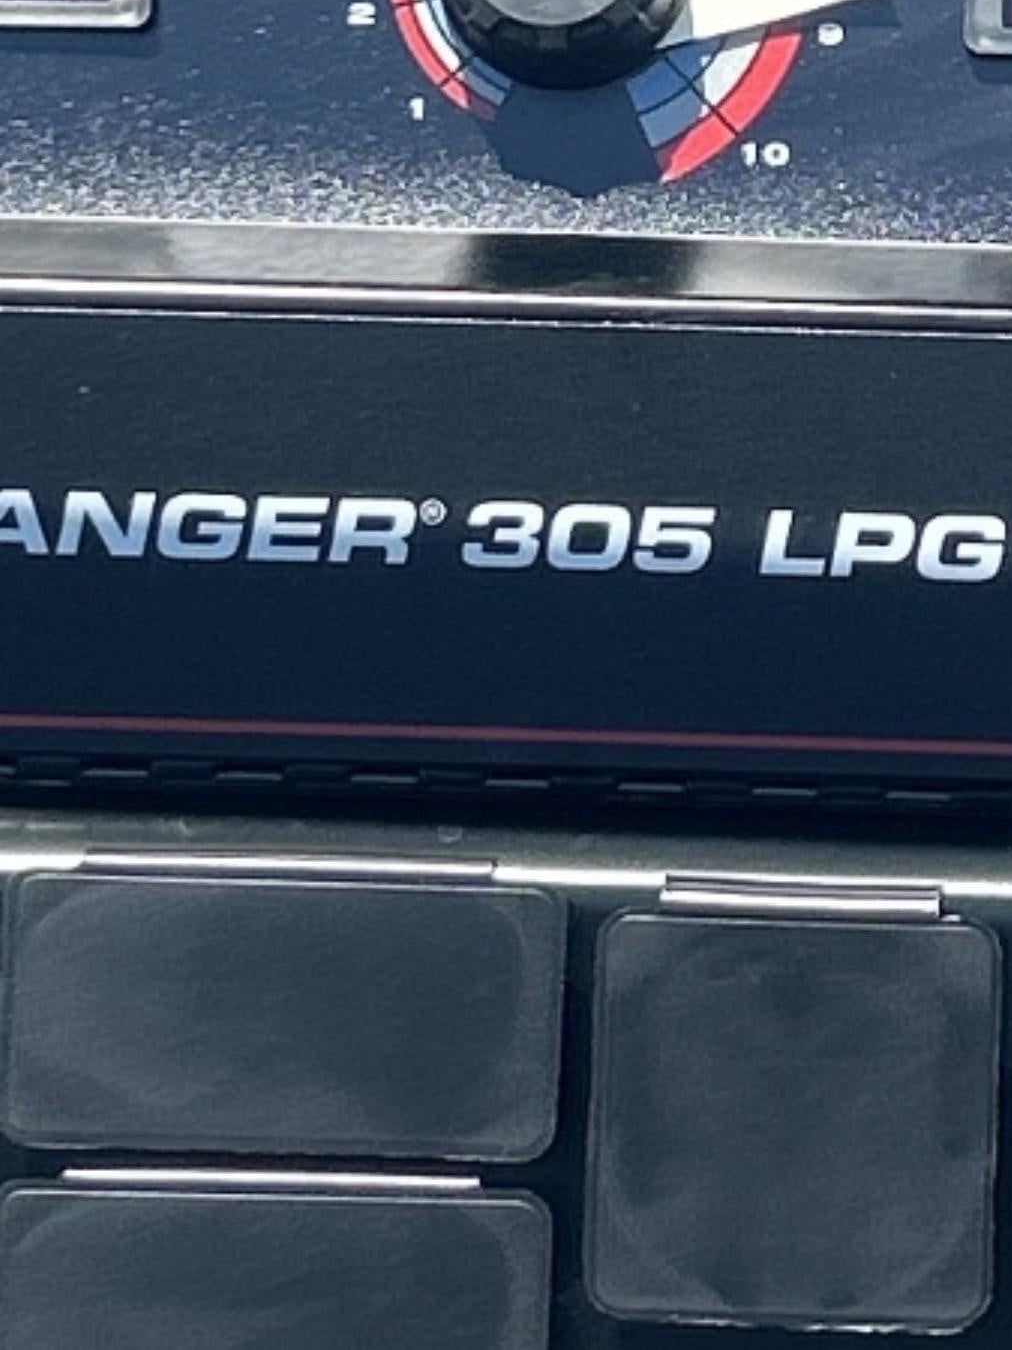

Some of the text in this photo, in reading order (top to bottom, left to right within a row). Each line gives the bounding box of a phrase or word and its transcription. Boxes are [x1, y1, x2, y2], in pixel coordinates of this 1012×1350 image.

[347, 2, 376, 25] 2
[409, 97, 424, 120] 1
[740, 142, 790, 167] 10
[462, 500, 717, 572] 305
[759, 508, 1007, 581] LPG
